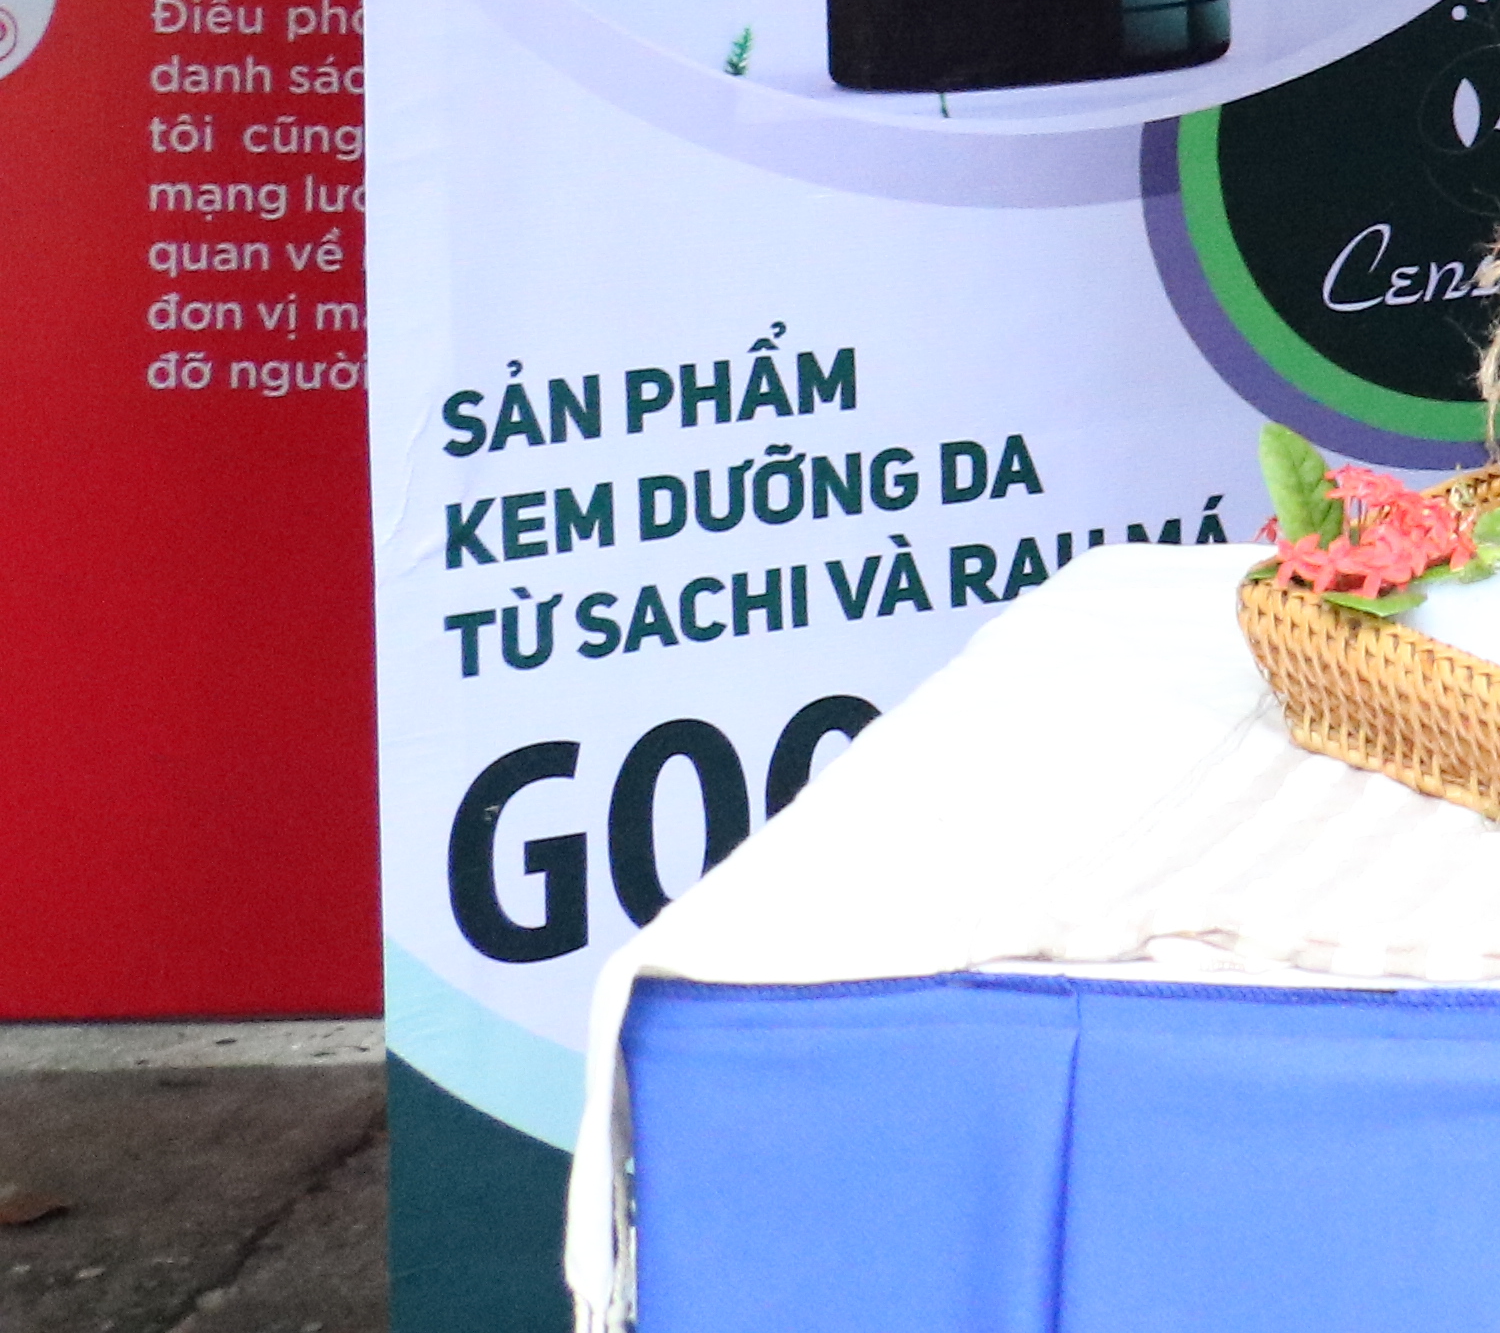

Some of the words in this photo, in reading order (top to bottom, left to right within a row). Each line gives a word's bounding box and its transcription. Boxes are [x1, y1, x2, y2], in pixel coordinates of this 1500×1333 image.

[150, 54, 271, 94] danh
[149, 113, 214, 153] tôi
[242, 115, 363, 161] cũng
[150, 182, 287, 221] mạng
[149, 240, 269, 277] quan
[147, 292, 243, 331] đơn
[257, 292, 297, 341] vị
[147, 351, 213, 391] đỡ
[442, 359, 600, 456] SẢN
[624, 320, 857, 434] PHẨM
[444, 480, 614, 570] KEM
[638, 443, 919, 543] DƯỠNG
[940, 434, 1044, 504] DA
[444, 587, 560, 677] TỪ
[576, 565, 808, 660] SACHI
[824, 535, 932, 622] VÀ
